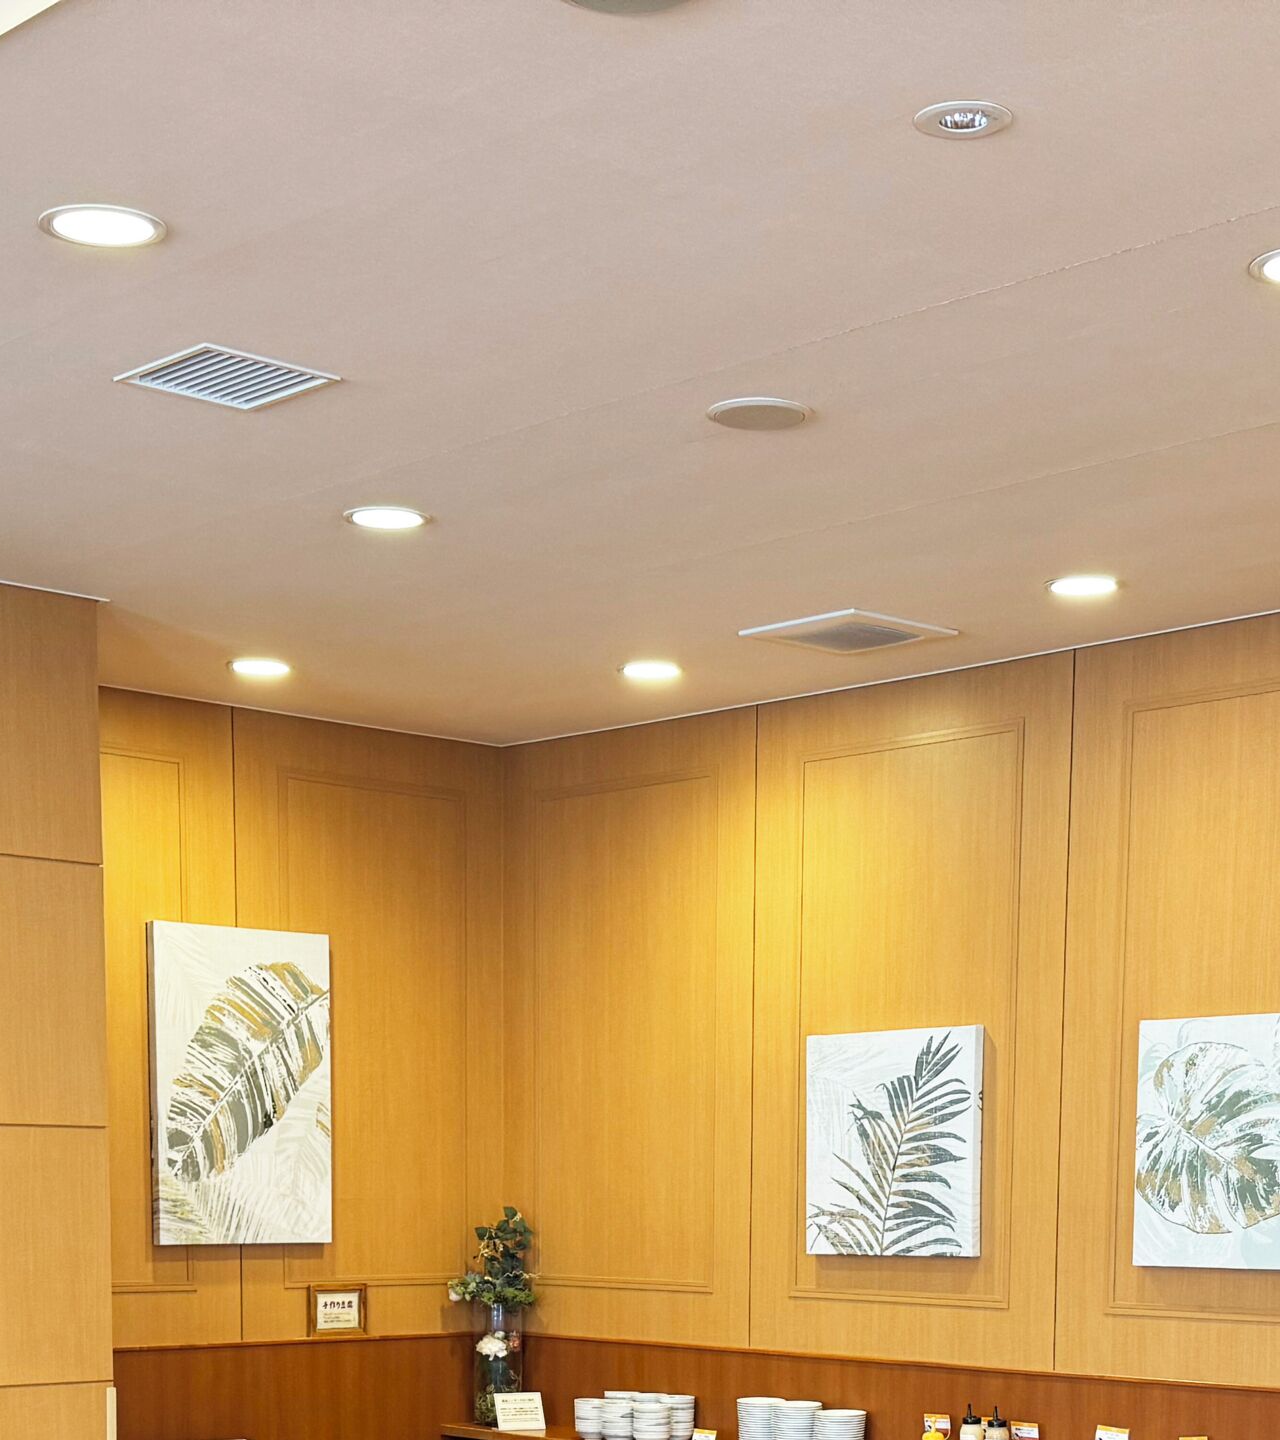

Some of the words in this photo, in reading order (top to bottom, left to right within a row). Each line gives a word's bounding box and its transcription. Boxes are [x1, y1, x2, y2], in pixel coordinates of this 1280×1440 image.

[322, 1300, 354, 1310] 手作り豆腐
